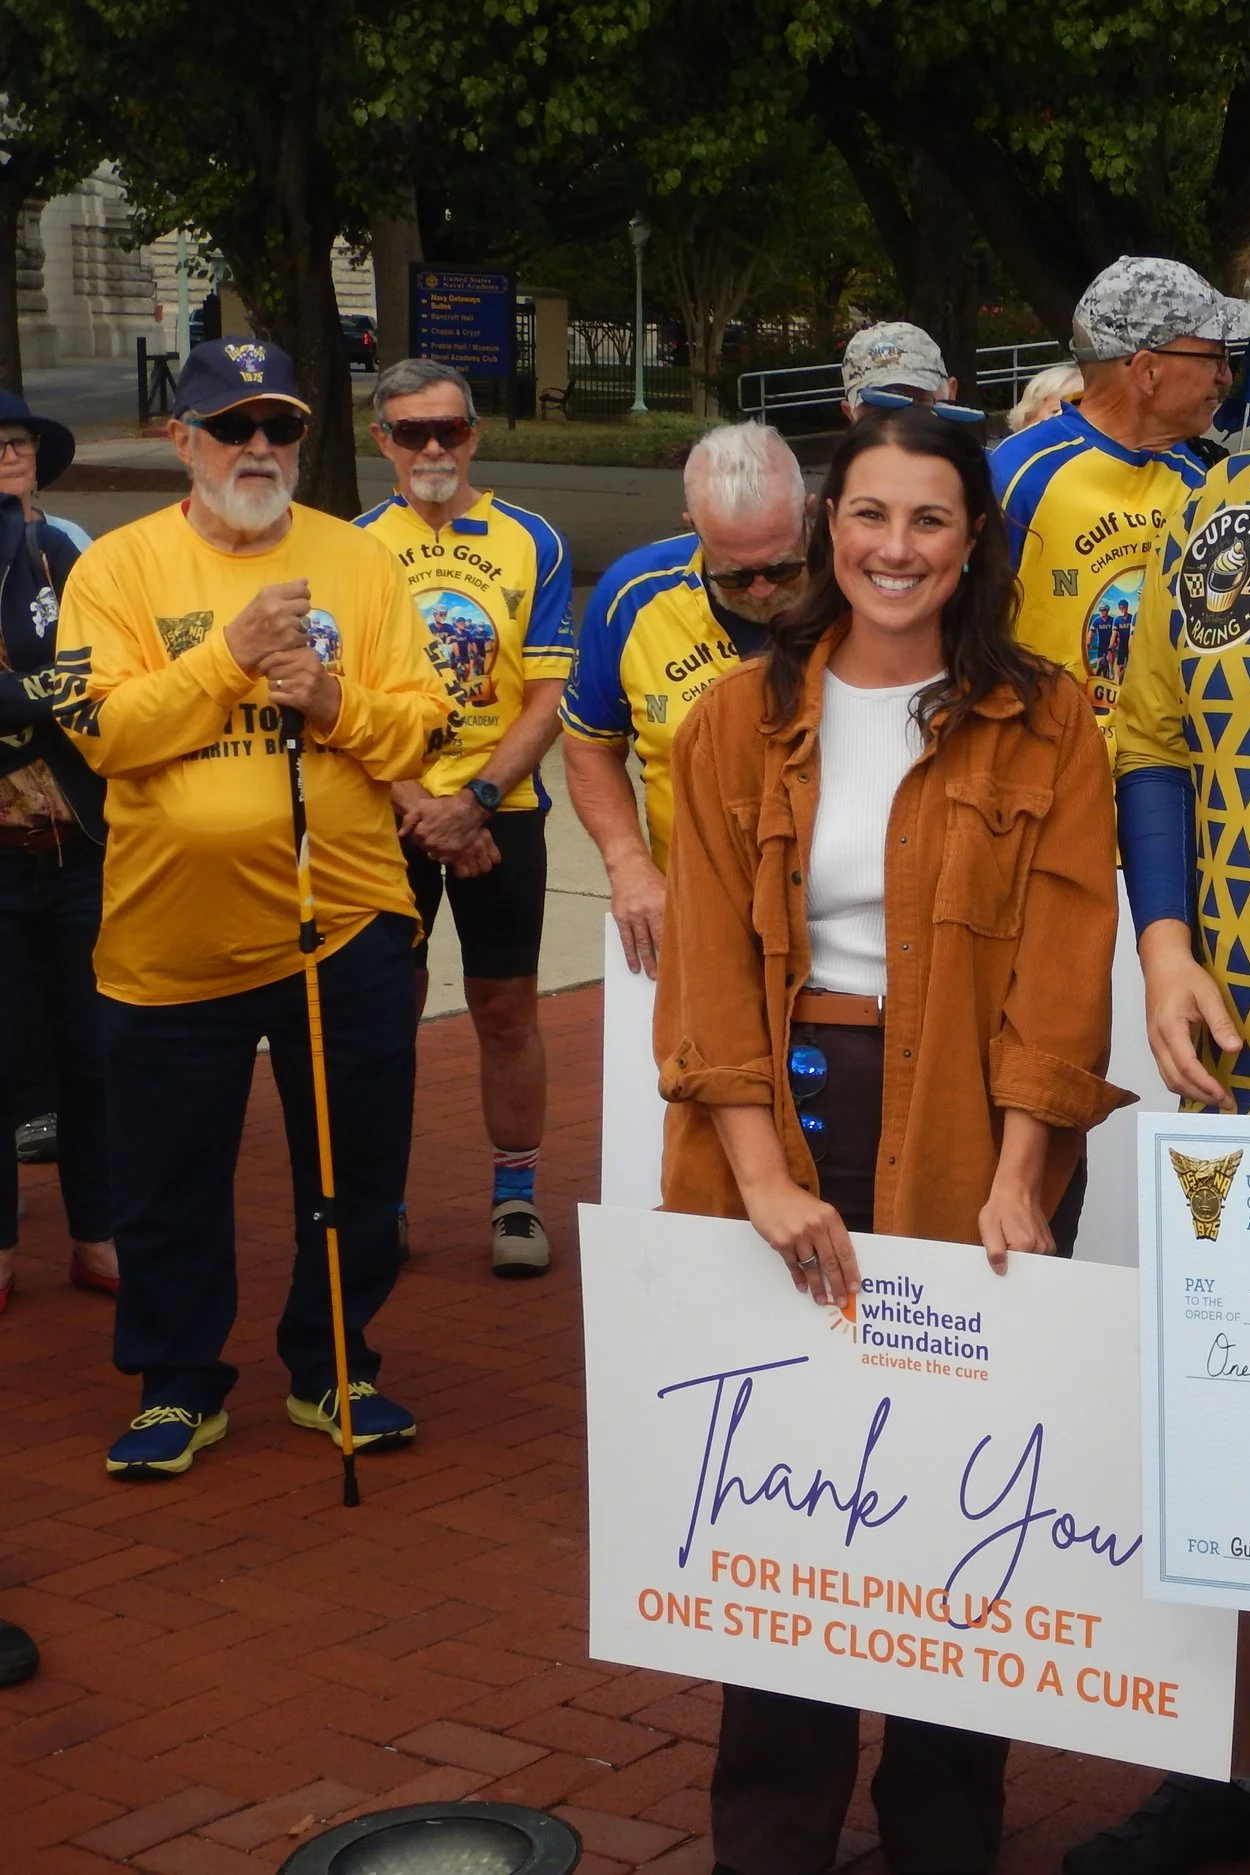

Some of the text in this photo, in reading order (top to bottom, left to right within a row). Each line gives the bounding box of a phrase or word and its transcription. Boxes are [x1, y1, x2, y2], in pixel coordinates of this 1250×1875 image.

[462, 329, 481, 338] Crypt
[1075, 511, 1120, 556] Gulf
[1123, 511, 1147, 528] to
[398, 543, 503, 582] lf to Goat
[1090, 542, 1138, 574] CHARITY
[408, 568, 490, 593] RITY BIKE RIDE
[1052, 568, 1079, 597] N
[1191, 618, 1241, 647] RACING
[664, 642, 715, 682] Gulf
[1093, 685, 1117, 703] GU
[461, 714, 501, 727] ACADEMY
[645, 694, 669, 724] N
[1193, 1220, 1219, 1241] 1975
[861, 1275, 924, 1304] emily
[1185, 1278, 1215, 1293] PAY
[1185, 1296, 1223, 1308] TO THE
[1185, 1309, 1242, 1323] ORDER OF
[861, 1303, 983, 1334] whitehead
[861, 1326, 990, 1361] foundation
[861, 1352, 989, 1381] activate the cure
[657, 1356, 1144, 1630] Thank You
[1188, 1539, 1220, 1555] FOR
[710, 1550, 1102, 1650] FOR HELPING US GET
[637, 1588, 1180, 1720] ONE STEP CLOSER TO A CURE
